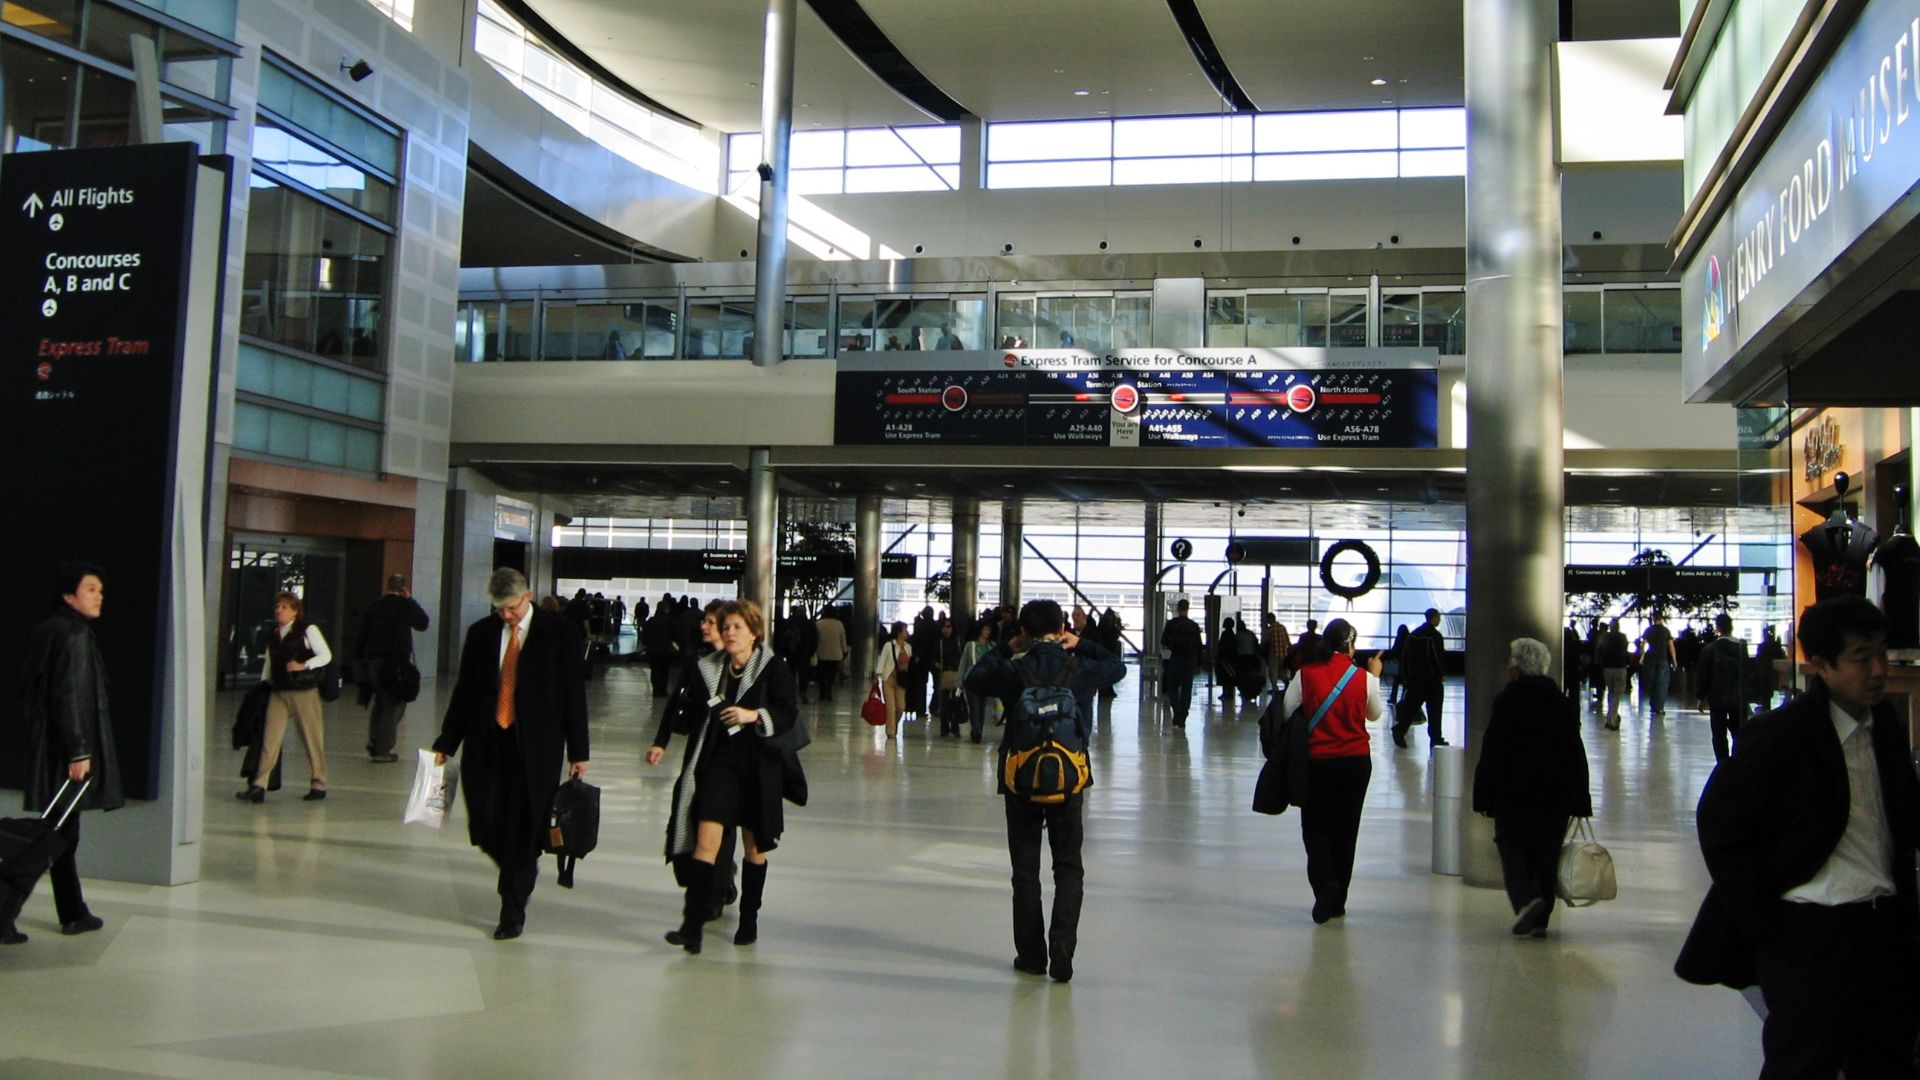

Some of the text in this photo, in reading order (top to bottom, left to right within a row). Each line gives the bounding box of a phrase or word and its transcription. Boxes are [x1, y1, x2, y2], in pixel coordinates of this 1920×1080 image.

[51, 187, 134, 210] All Flights
[1727, 197, 1776, 313] HENRY
[1779, 139, 1832, 257] FORD
[46, 252, 141, 269] Concourses
[44, 272, 131, 294] A, B and C
[38, 337, 149, 360] Express Tram
[1022, 355, 1257, 368] Express Tram Service for Concourse A
[899, 432, 923, 440] Express
[1163, 433, 1198, 441] Walkways
[1333, 434, 1359, 442] Express
